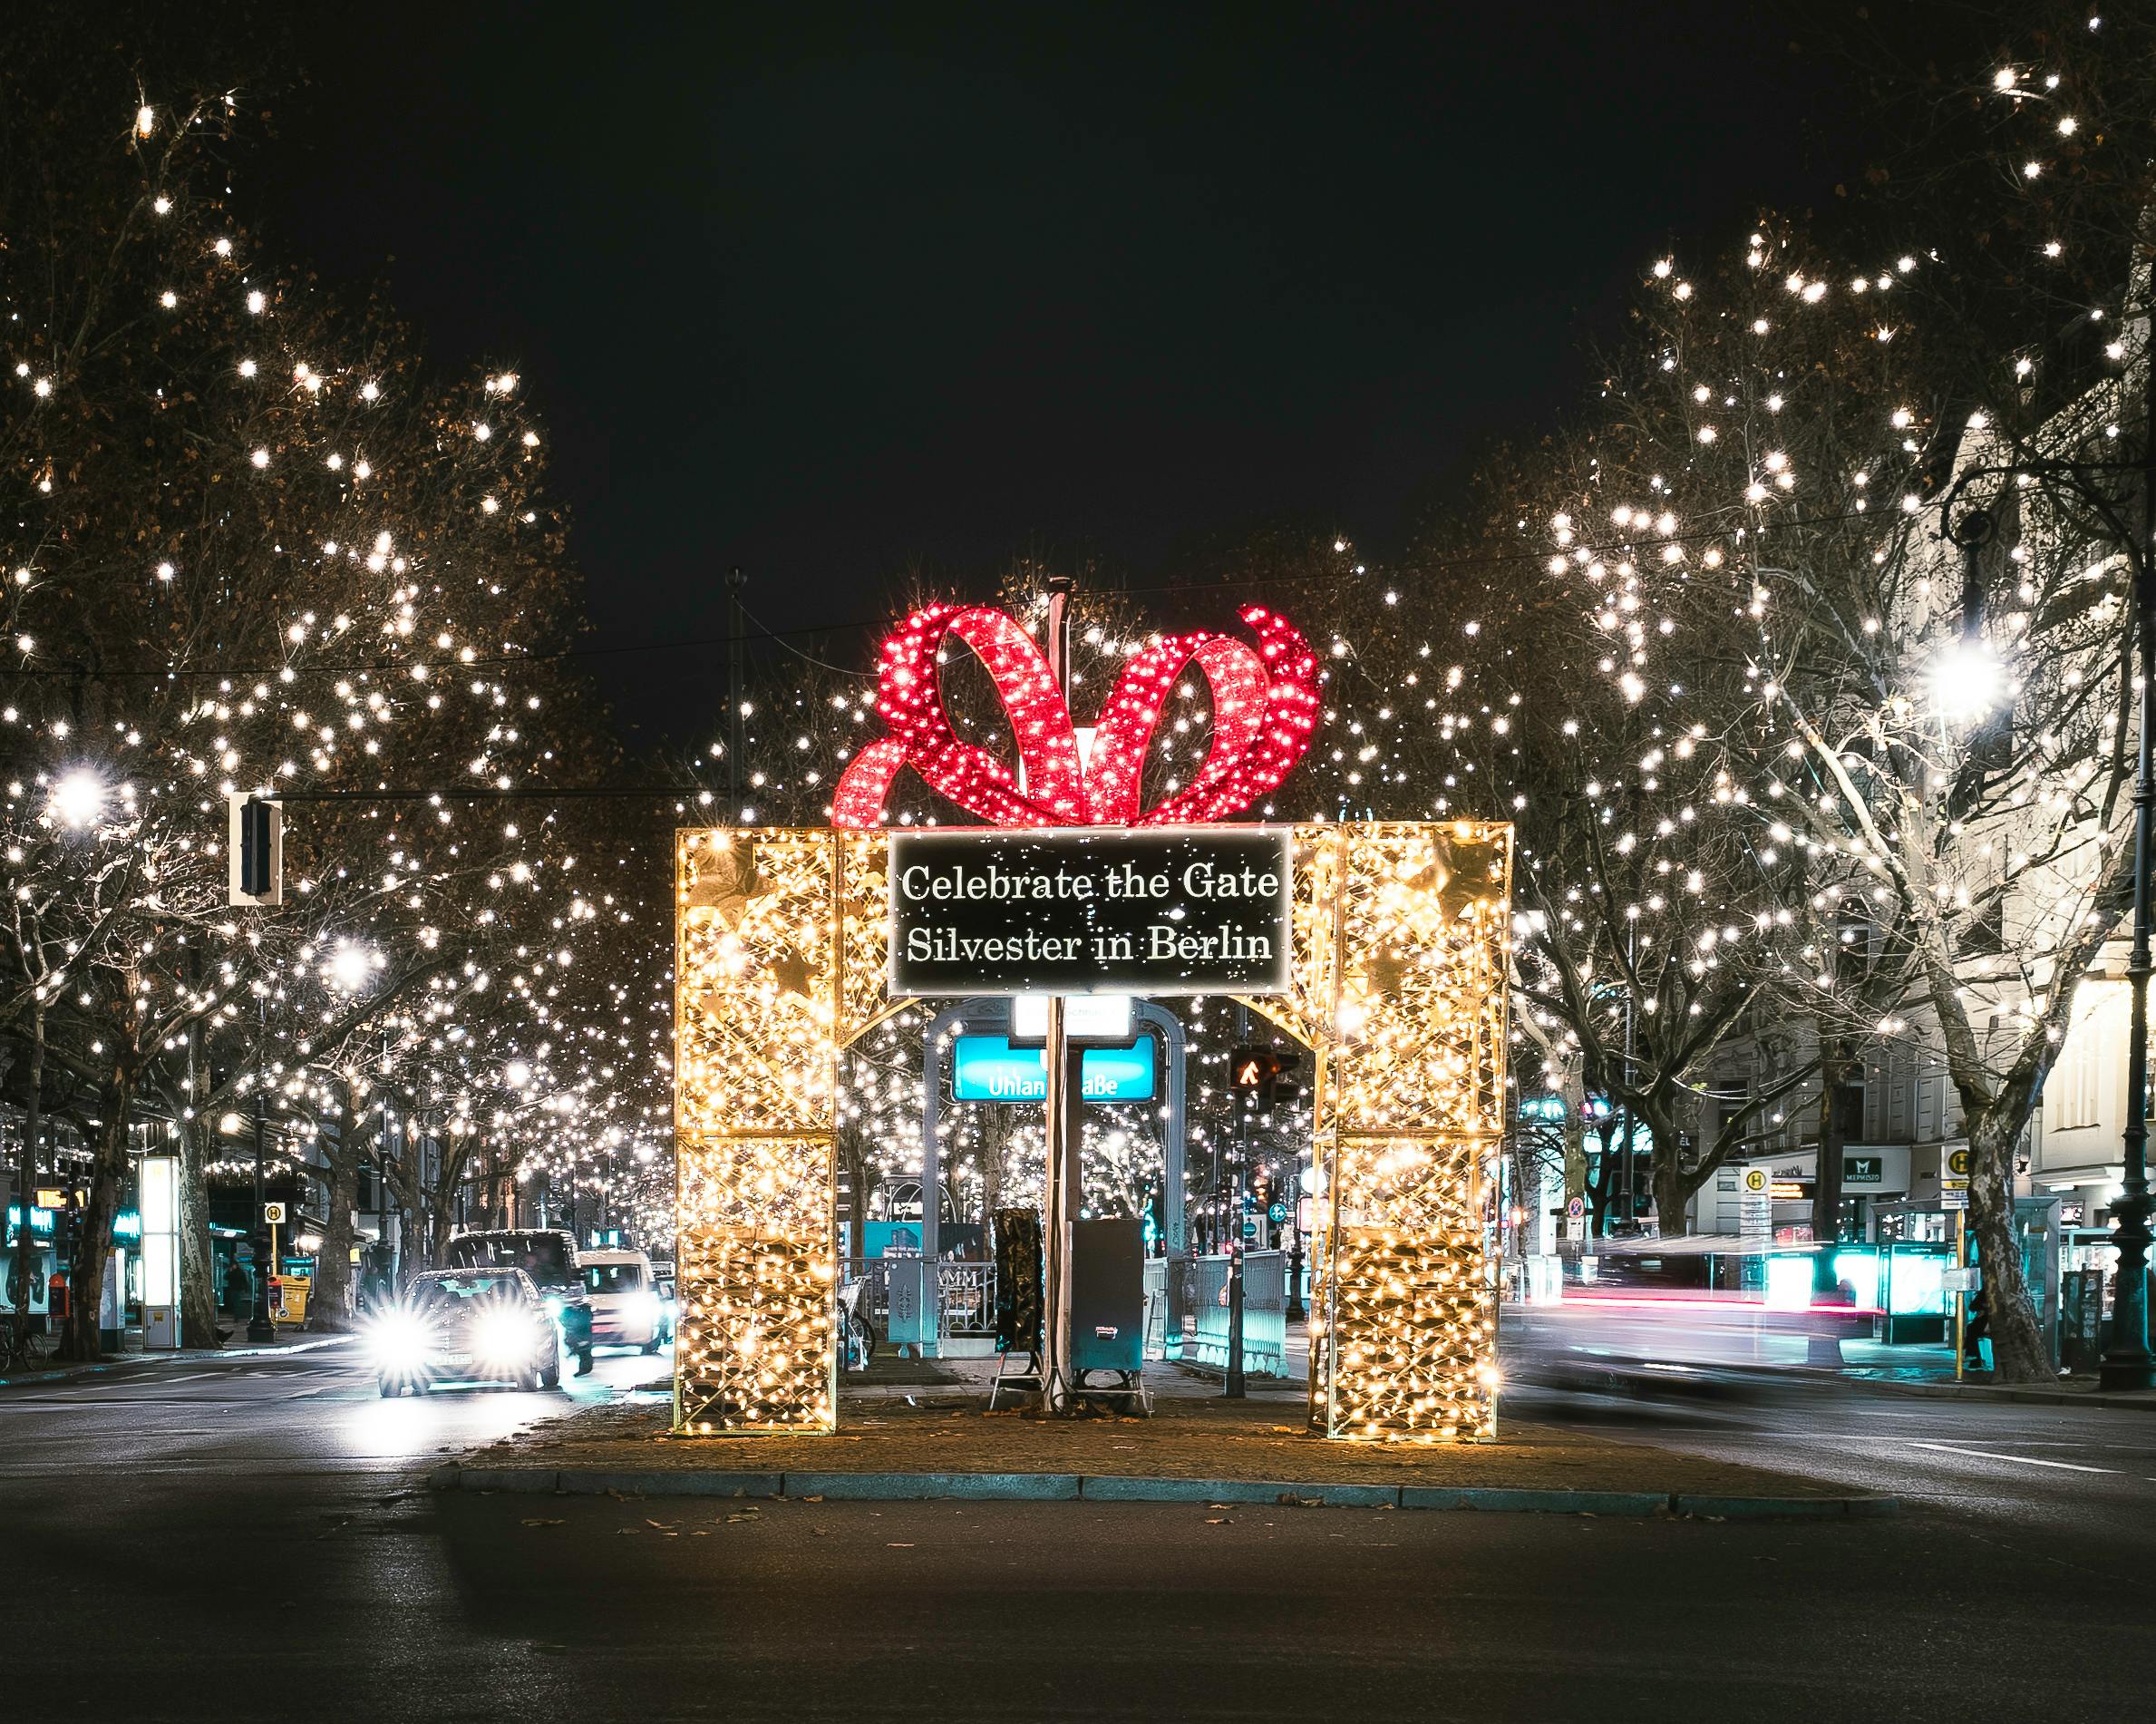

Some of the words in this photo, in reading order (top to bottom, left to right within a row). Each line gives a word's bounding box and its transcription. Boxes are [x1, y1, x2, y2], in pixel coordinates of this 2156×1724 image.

[902, 865, 1093, 901] Celebrate
[1106, 863, 1170, 899] the
[1183, 862, 1279, 898] Gate
[907, 926, 1083, 962] Silvester
[1094, 926, 1134, 960] in
[1146, 924, 1273, 960] Berlin
